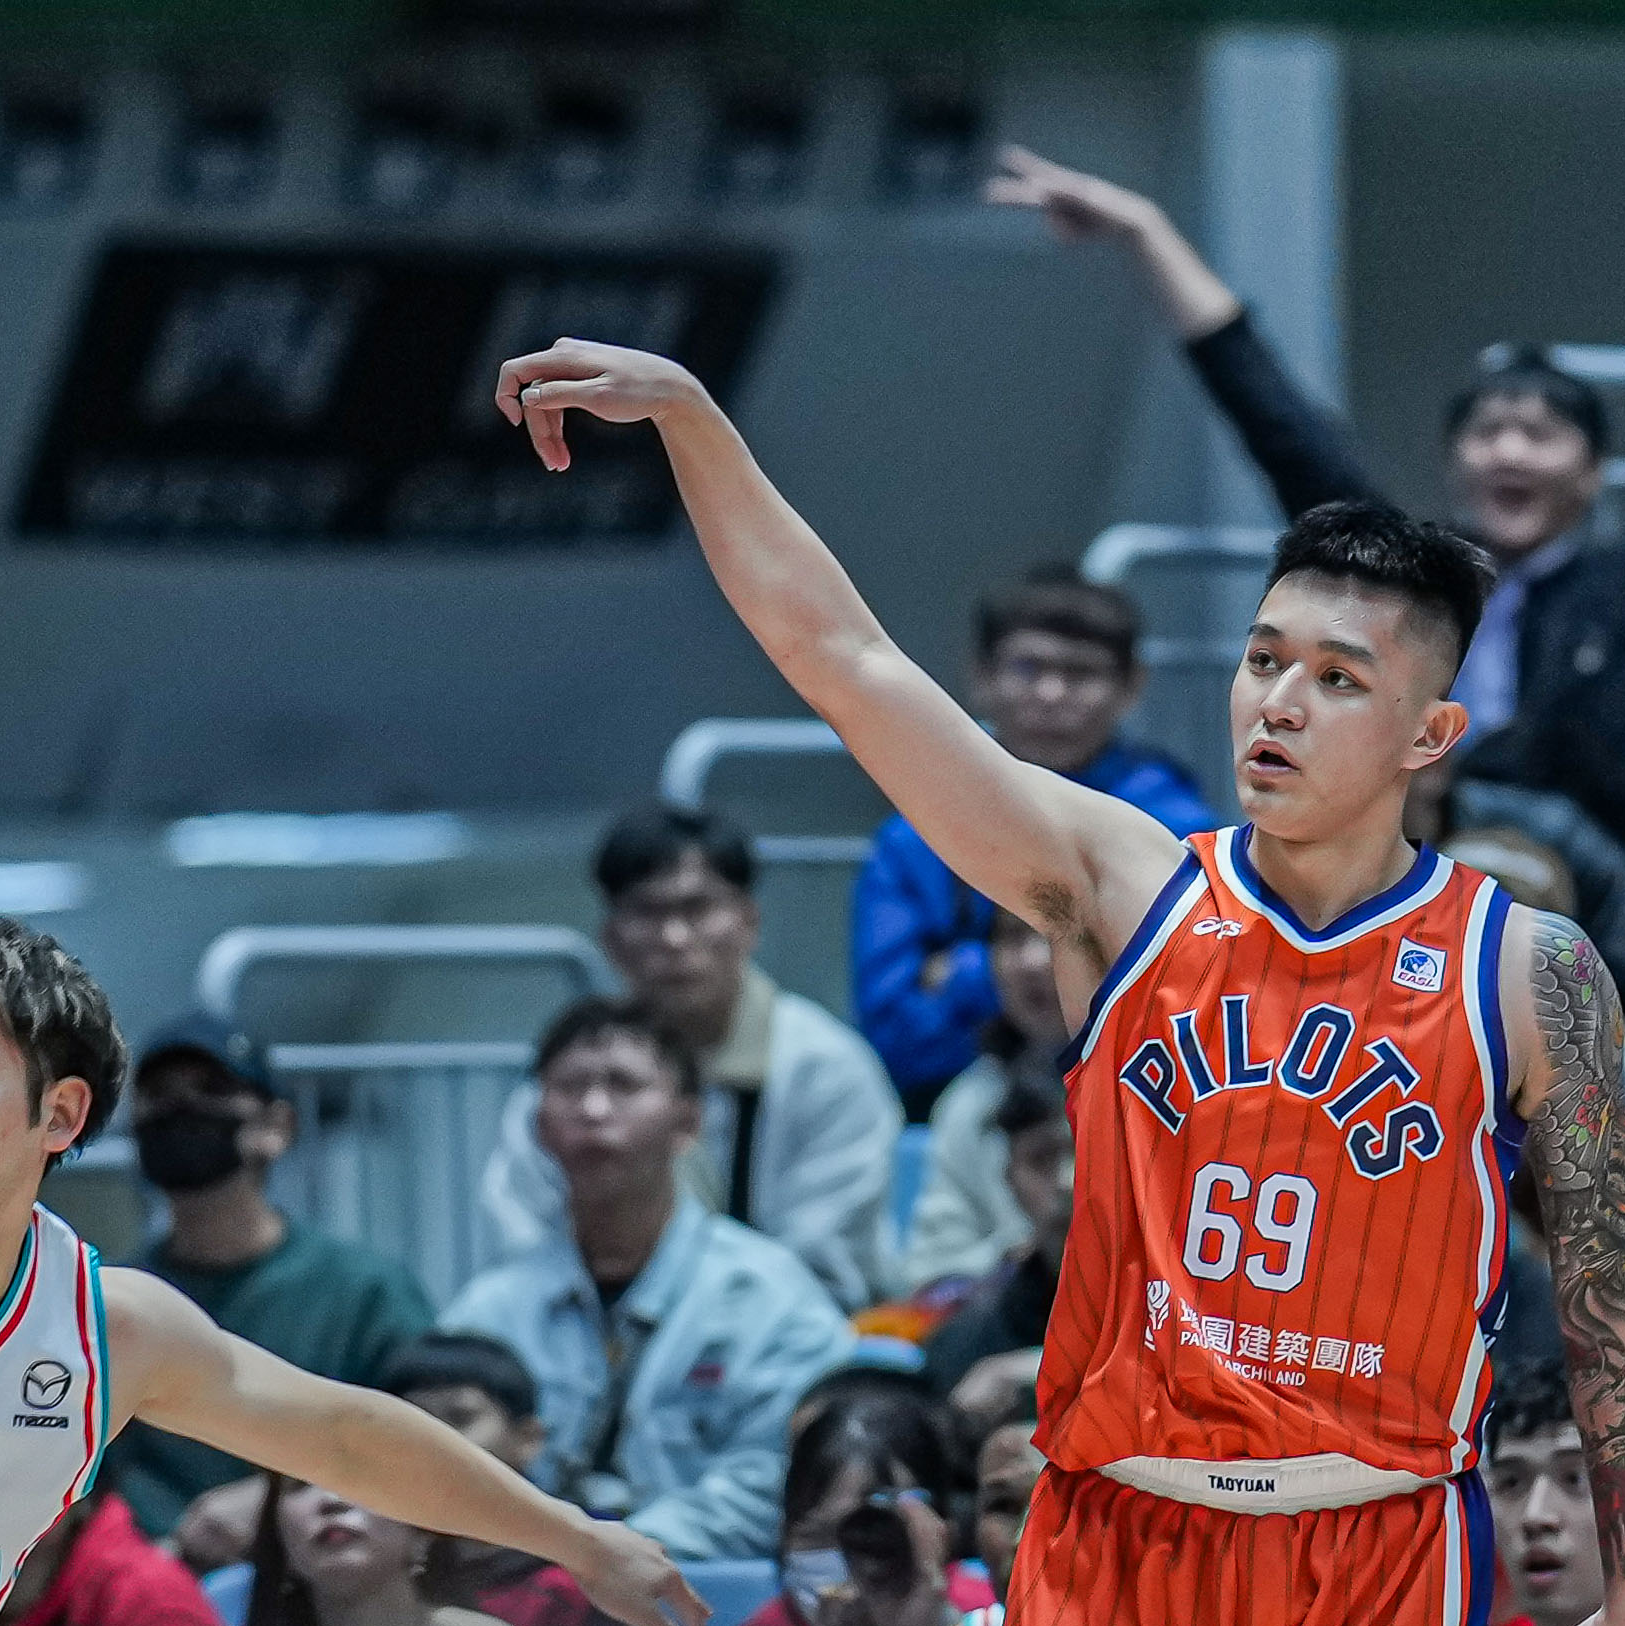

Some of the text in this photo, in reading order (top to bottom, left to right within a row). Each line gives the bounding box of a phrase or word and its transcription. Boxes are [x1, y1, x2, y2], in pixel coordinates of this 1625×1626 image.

[1397, 970, 1436, 987] EASL
[1118, 992, 1446, 1181] PILOTS
[1180, 1160, 1319, 1294] 69
[1207, 1474, 1276, 1493] TAOYUAN
